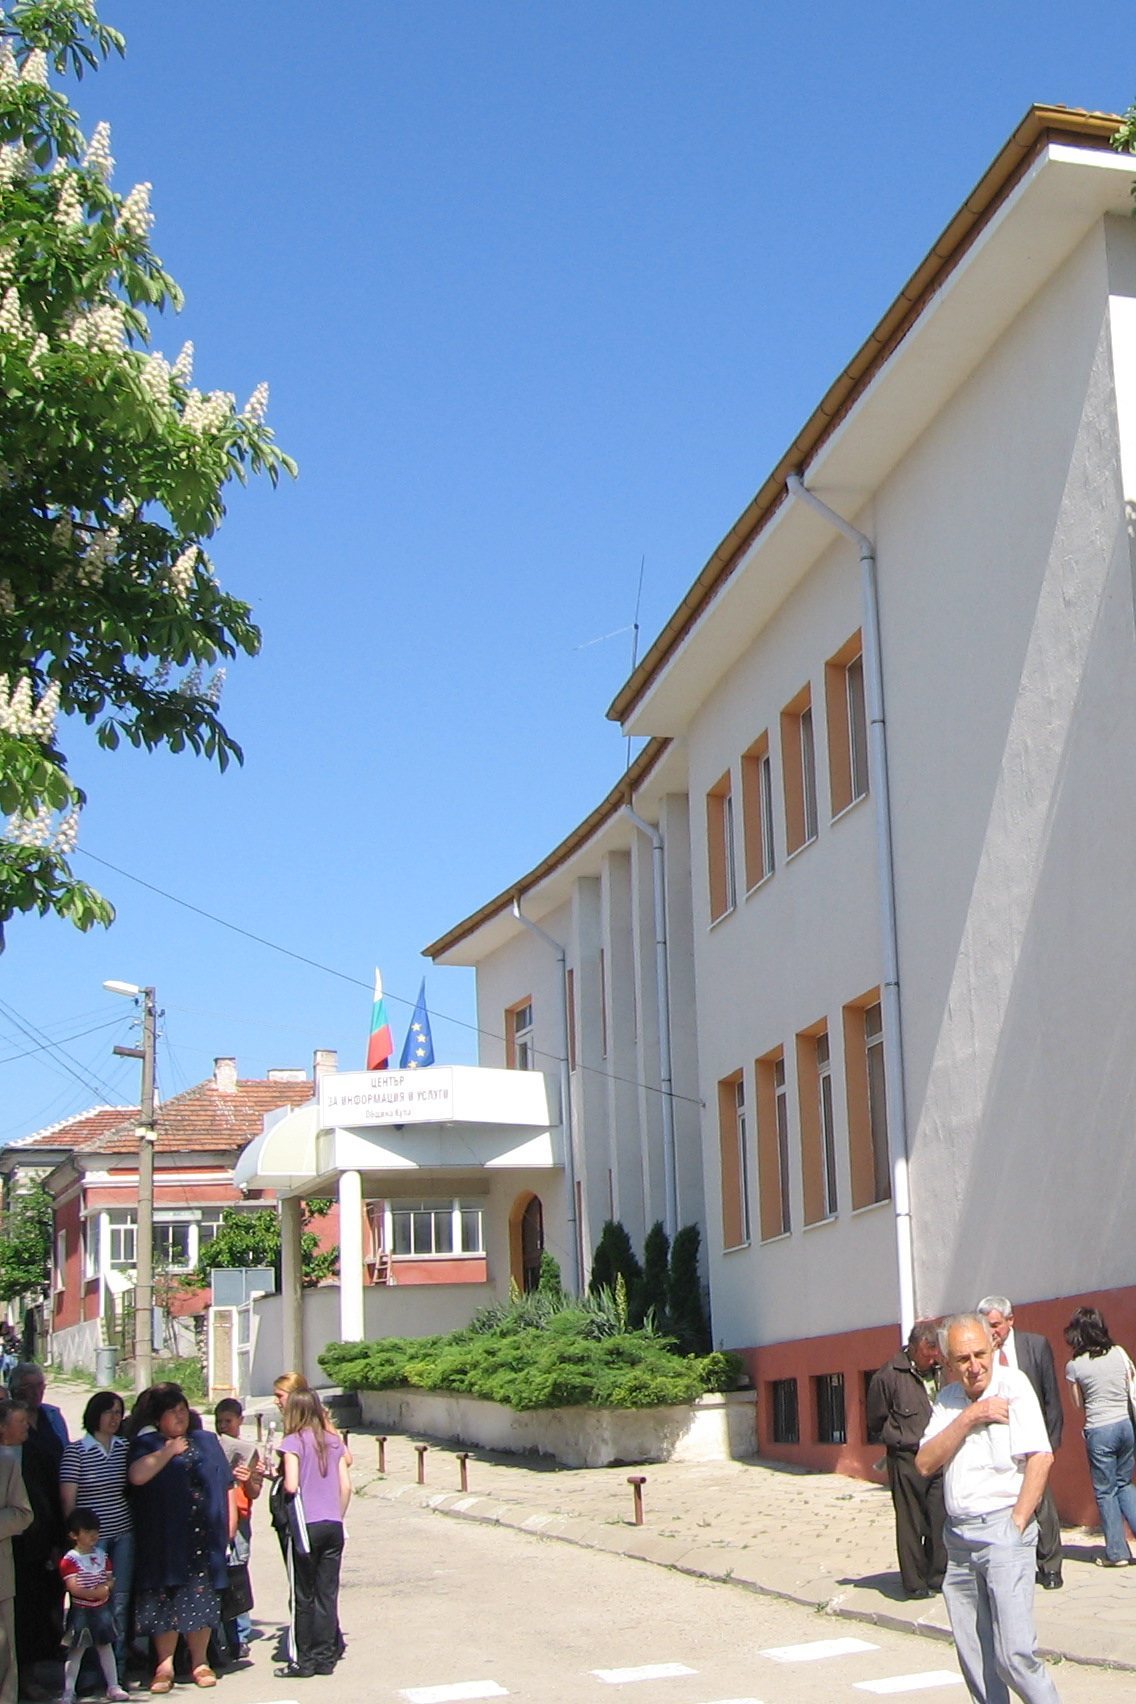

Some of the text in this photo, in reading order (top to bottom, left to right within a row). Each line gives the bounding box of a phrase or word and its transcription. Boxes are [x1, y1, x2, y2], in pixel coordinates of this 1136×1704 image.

[371, 1076, 405, 1088] ЦЕНТЪР
[341, 1091, 405, 1105] ИНФОРМАЦИЯ
[416, 1089, 449, 1101] УСЛУГИ
